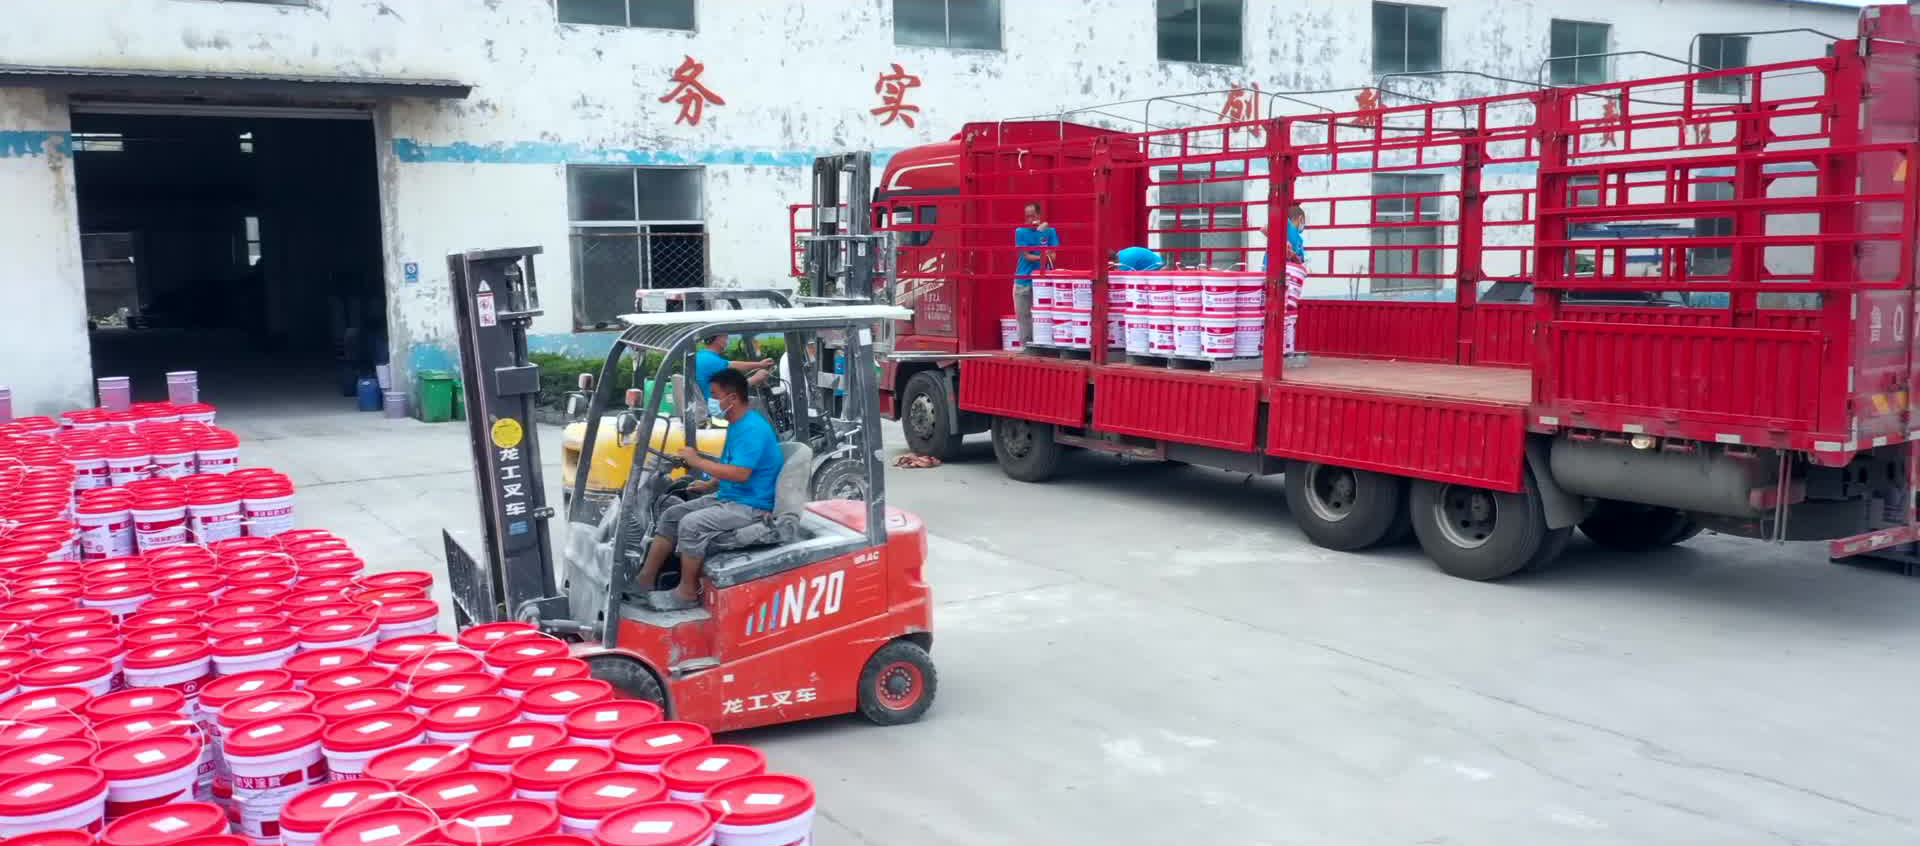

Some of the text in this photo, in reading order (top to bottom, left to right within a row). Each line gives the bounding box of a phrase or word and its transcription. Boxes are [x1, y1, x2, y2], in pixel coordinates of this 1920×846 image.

[499, 447, 526, 516] 龙工叉车
[780, 569, 845, 628] N20
[722, 687, 817, 715] 龙工叉车
